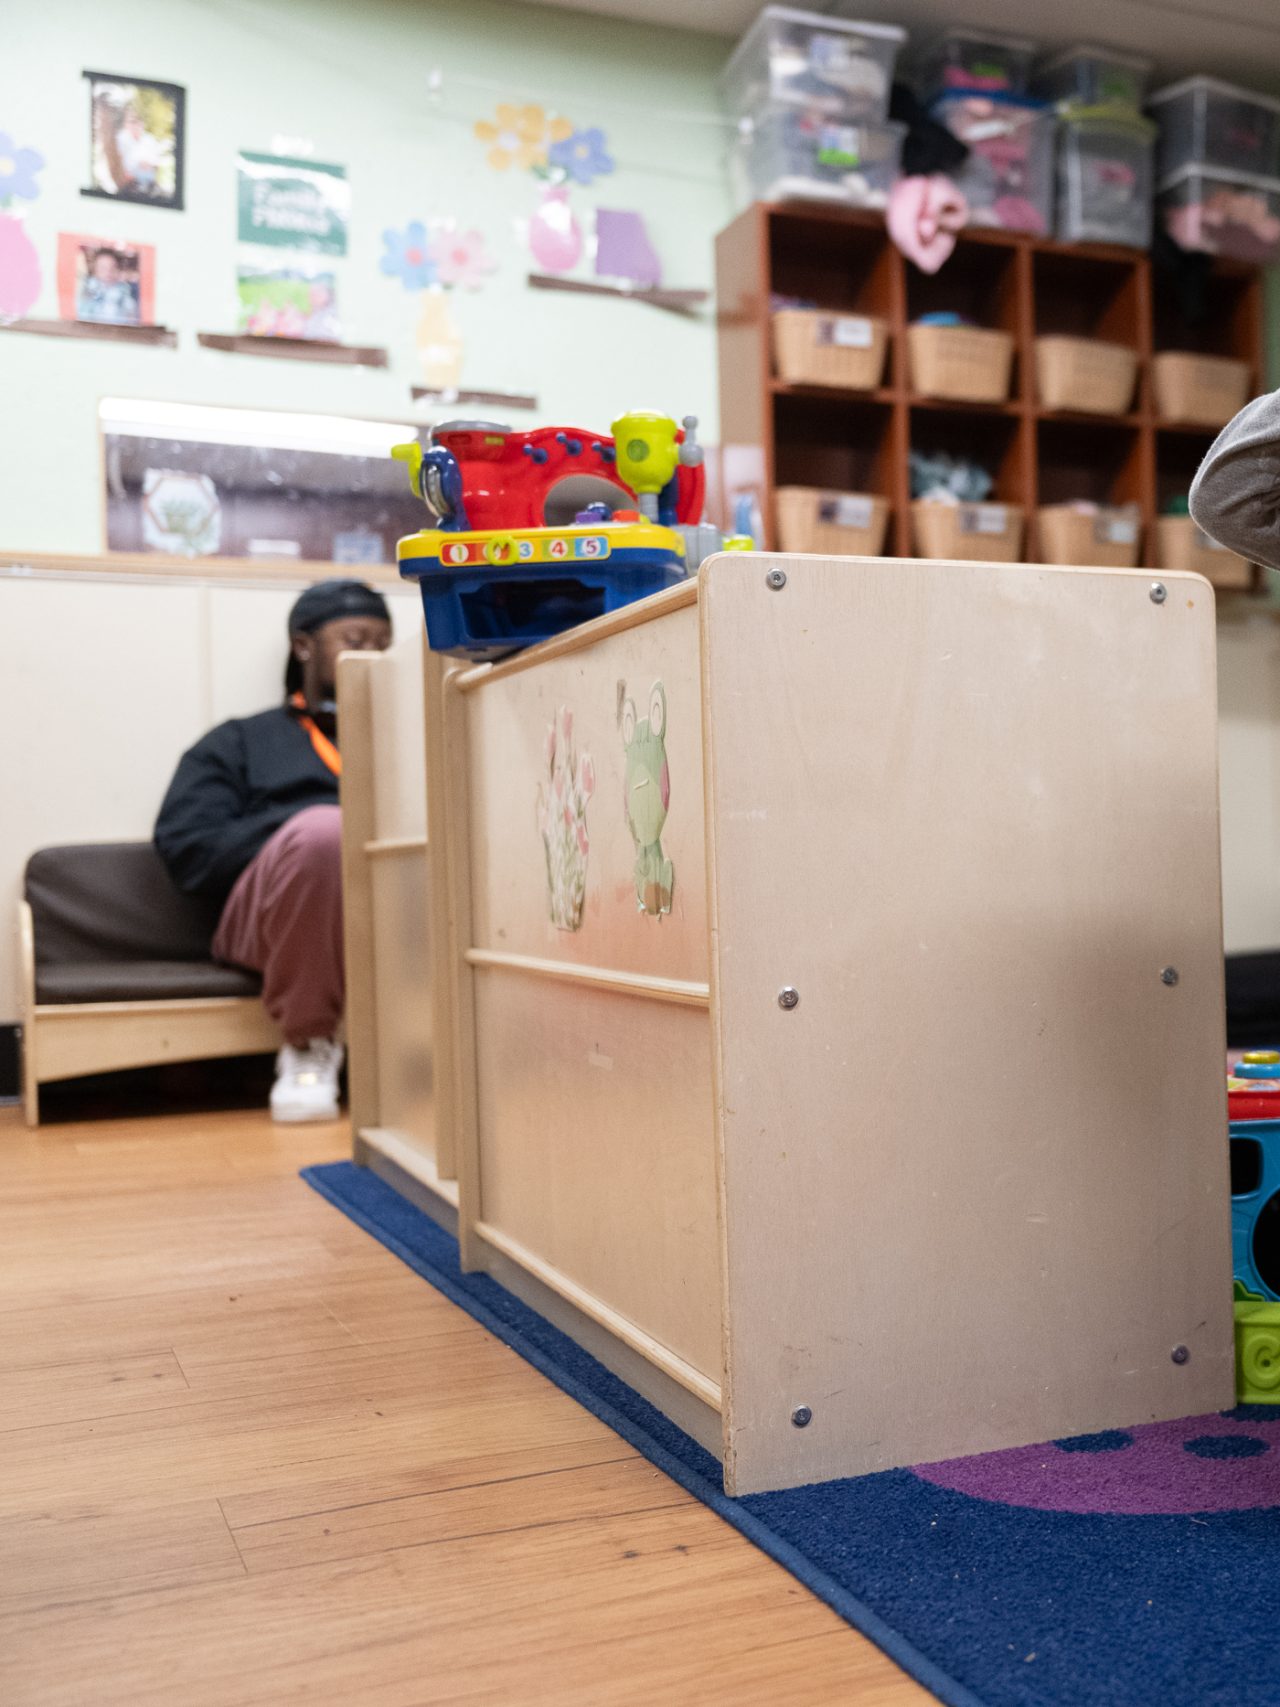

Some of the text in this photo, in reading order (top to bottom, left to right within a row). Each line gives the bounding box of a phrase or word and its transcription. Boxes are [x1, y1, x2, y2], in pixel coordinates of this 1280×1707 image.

[519, 542, 531, 558] 3
[551, 541, 565, 557] 4
[585, 539, 598, 555] 5
